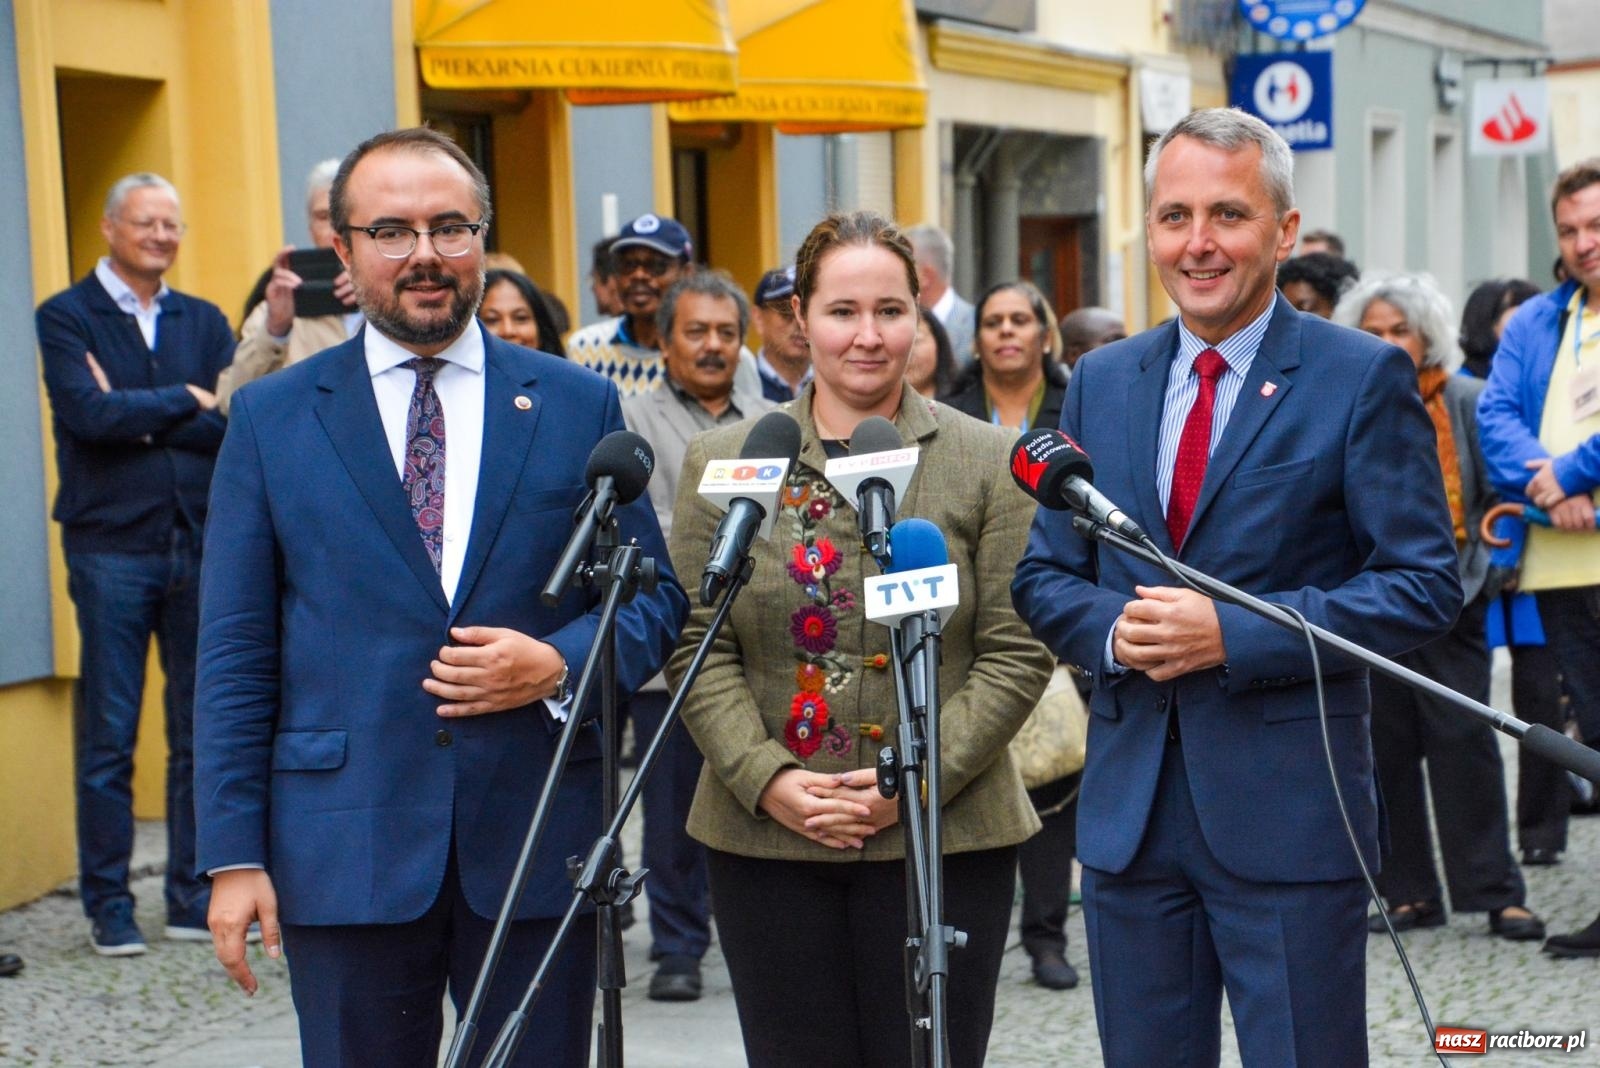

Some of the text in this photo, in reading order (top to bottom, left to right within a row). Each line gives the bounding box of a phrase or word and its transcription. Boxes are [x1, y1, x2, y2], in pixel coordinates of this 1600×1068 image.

[430, 57, 555, 77] PIEKARNIA
[558, 57, 667, 77] CUKIERNIA
[1025, 433, 1052, 451] Polskie
[1031, 440, 1053, 456] Radio
